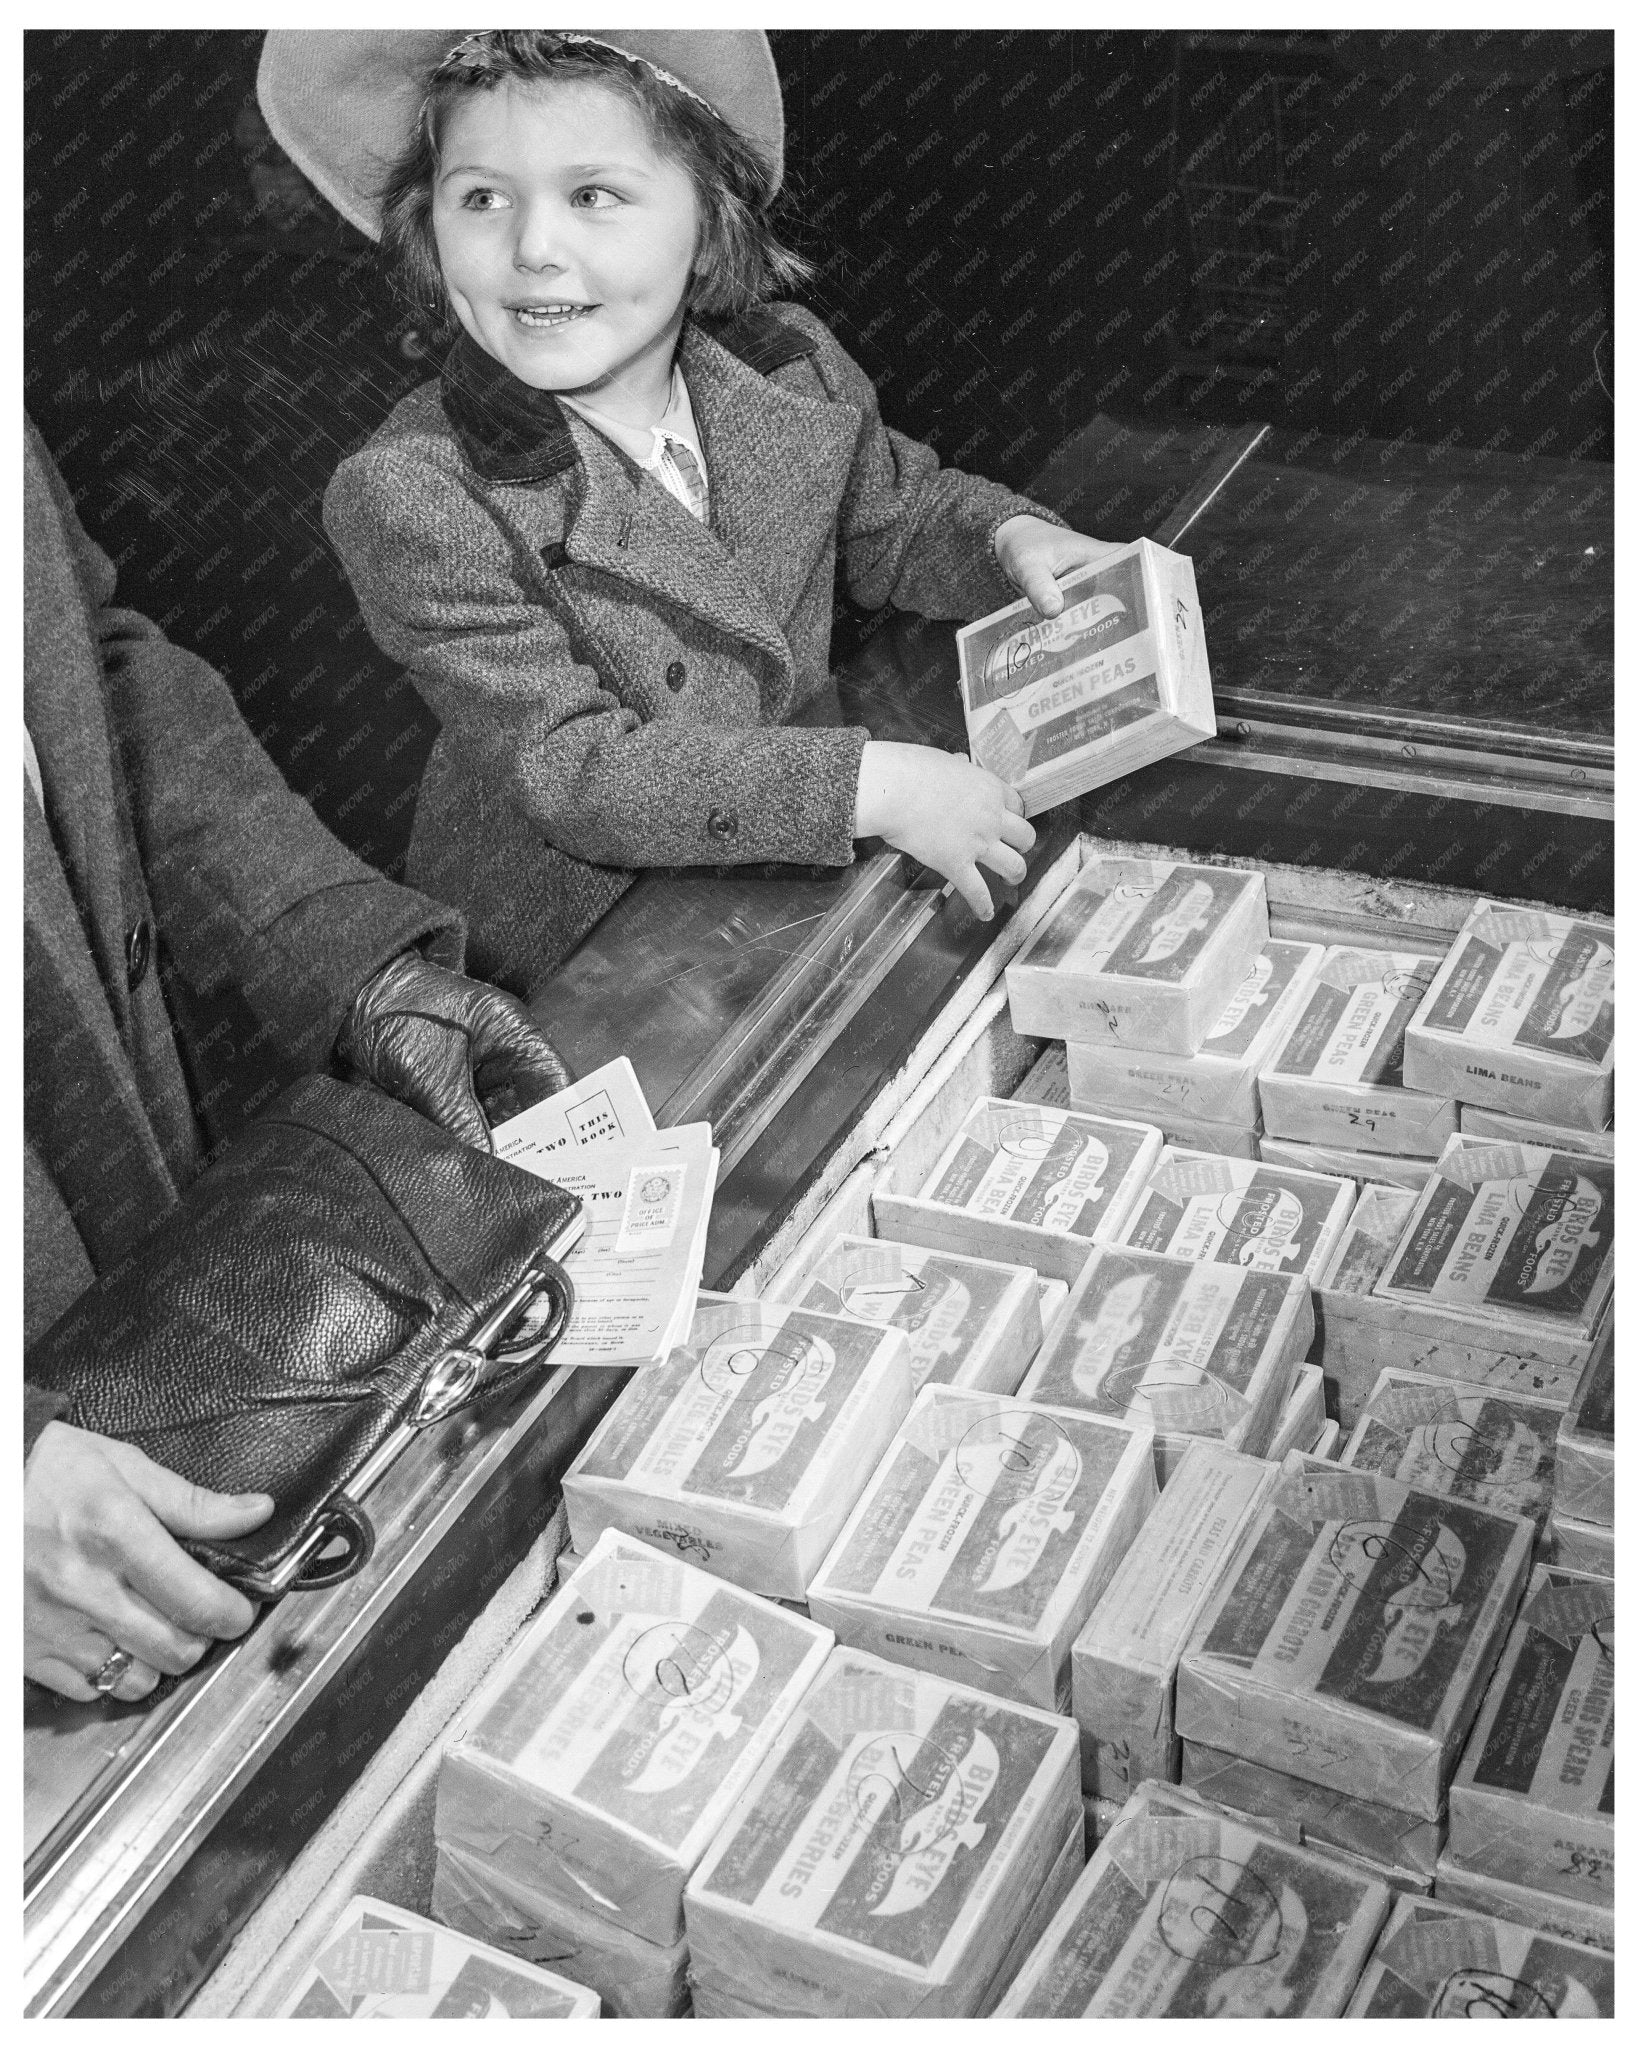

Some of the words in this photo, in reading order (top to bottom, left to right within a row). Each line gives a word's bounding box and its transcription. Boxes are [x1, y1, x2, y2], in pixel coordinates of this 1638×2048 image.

[1073, 596, 1100, 624] EYE
[1082, 614, 1120, 640] FOODS
[1027, 678, 1084, 722] GREEN
[1089, 654, 1137, 693] PEAS
[1156, 930, 1184, 950] EYE
[1503, 950, 1531, 980] LIMA
[1217, 1007, 1244, 1027] EYE
[1345, 991, 1378, 1030] GREEN
[1478, 984, 1515, 1027] BEANS
[1569, 1001, 1595, 1027] EYE
[1358, 1011, 1382, 1047] QUICK-FROZEN
[1326, 1033, 1357, 1066] PEAS
[1465, 1065, 1497, 1081] LIMA
[1500, 1073, 1542, 1091] BEANS
[579, 1111, 609, 1132] THIS
[580, 1122, 616, 1146] BOOK
[1348, 1113, 1376, 1132] 29
[495, 1137, 523, 1155] AMERICA
[556, 1175, 586, 1184] AMERICA
[995, 1159, 1024, 1185] IMA
[1066, 1154, 1105, 1199] BIRDS
[591, 1190, 623, 1201] TWO
[998, 1175, 1027, 1215] QUICK-FROZEN
[1248, 1192, 1276, 1234] FROSTED
[1473, 1191, 1505, 1228] LIMA
[1050, 1202, 1078, 1227] EYE
[1182, 1206, 1213, 1241] LIMA
[1261, 1208, 1297, 1258] BIRDS
[1557, 1196, 1596, 1246] BIRDS
[1446, 1231, 1486, 1283] BEANS
[1483, 1216, 1510, 1261] QUICK-FROZEN
[1516, 1252, 1537, 1285] FOODS
[1544, 1248, 1572, 1277] EYE
[780, 1359, 833, 1417] BIRDS
[719, 1428, 752, 1468] FOODS
[757, 1421, 795, 1456] EYE
[925, 1460, 975, 1522] GREEN
[1027, 1465, 1078, 1528] BIRDS
[935, 1492, 975, 1551] QUICK-FROZEN
[1207, 1516, 1227, 1537] PEAS
[892, 1527, 939, 1581] PEAS
[969, 1539, 1000, 1582] FOODS
[1005, 1533, 1043, 1570] EYE
[1197, 1537, 1216, 1558] AND
[1176, 1556, 1206, 1595] CARROTS
[683, 1627, 731, 1688] FROSTED
[885, 1633, 934, 1650] GREEN
[619, 1729, 659, 1779] FOODS
[658, 1729, 703, 1776] EYE
[932, 1763, 994, 1842] BIRDS
[862, 1851, 901, 1904] FOODS
[903, 1845, 949, 1893] EYE
